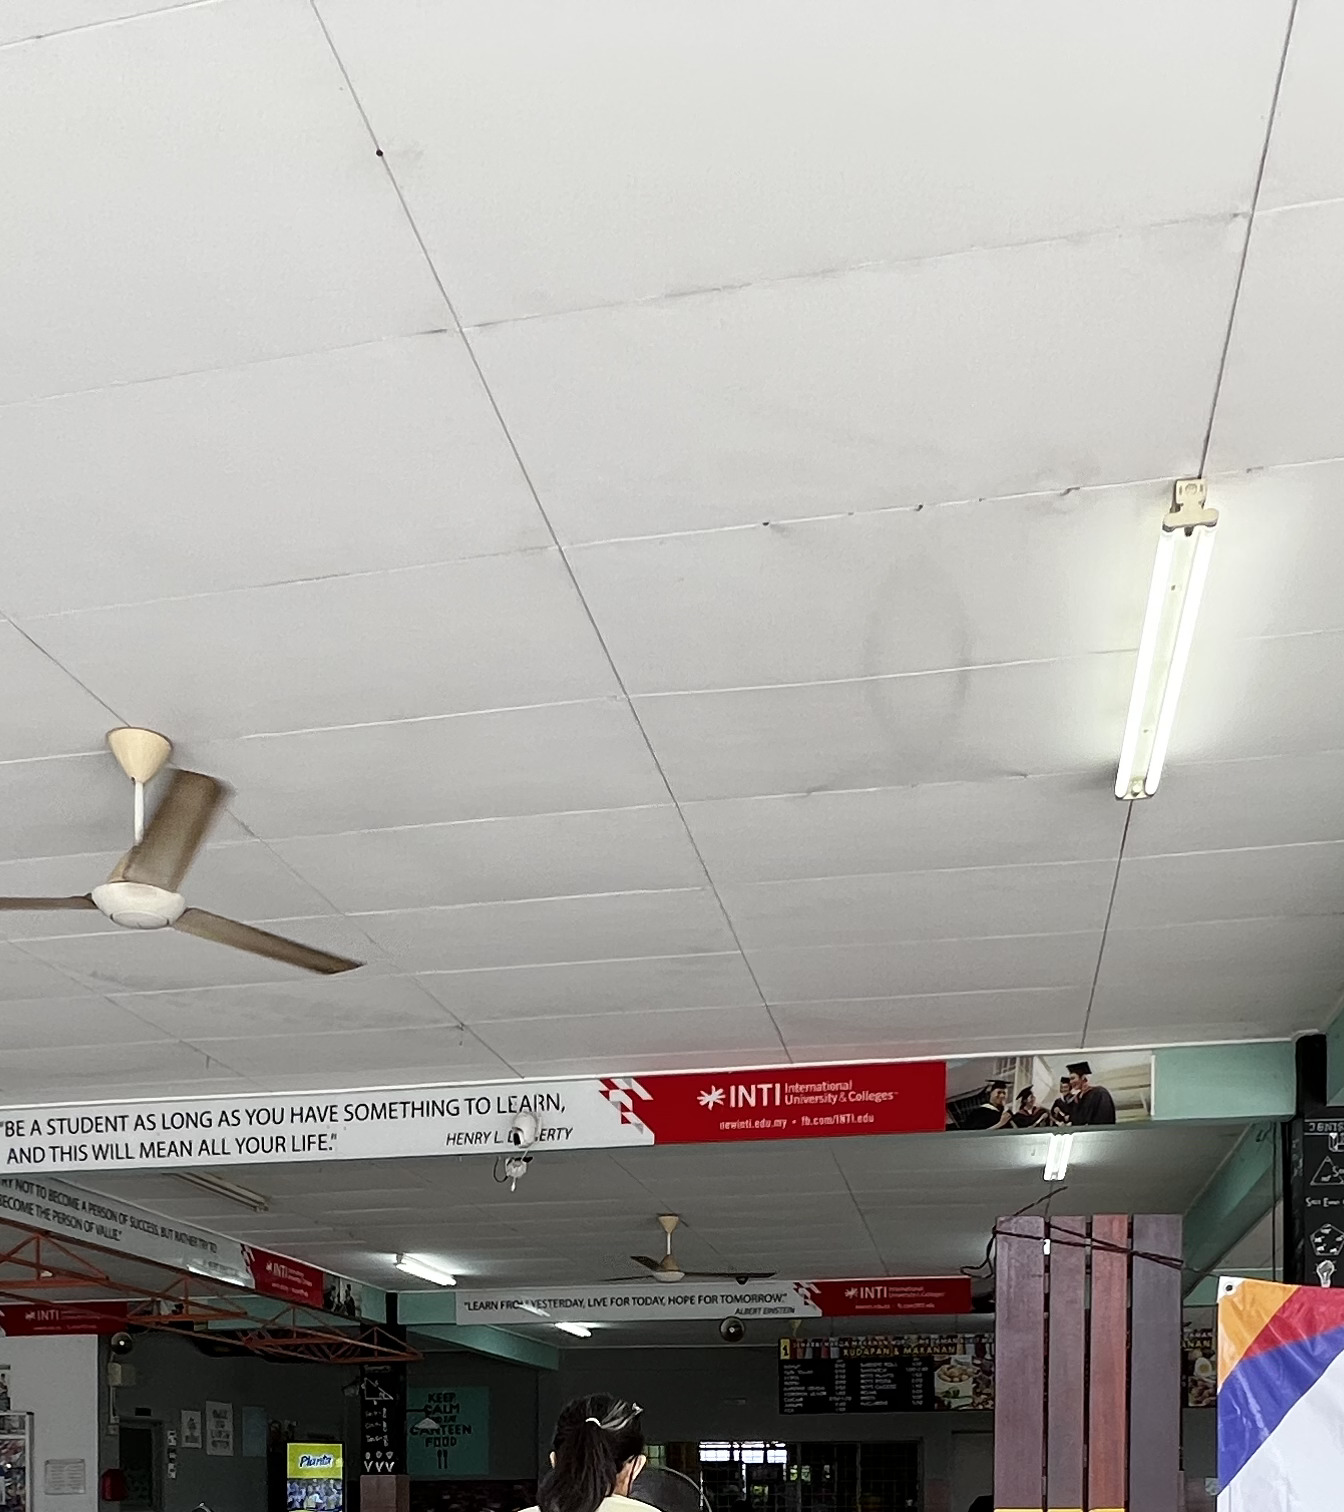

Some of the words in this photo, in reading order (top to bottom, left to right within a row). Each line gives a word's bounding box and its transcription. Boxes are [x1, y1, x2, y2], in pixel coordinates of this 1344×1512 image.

[784, 1079, 853, 1094] International
[729, 1082, 781, 1109] INTI
[784, 1093, 838, 1106] University
[838, 1092, 847, 1102] &
[30, 1119, 42, 1136] A
[46, 1115, 129, 1136] STUDENT
[133, 1113, 157, 1132] AS
[161, 1110, 213, 1130] LONG
[217, 1109, 241, 1128] AS
[245, 1107, 285, 1126] YOU
[290, 1105, 339, 1124] HAVE
[343, 1099, 460, 1123] SOMETHING
[464, 1096, 491, 1116] TO
[497, 1092, 566, 1114] LEARN,
[446, 1130, 492, 1146] HENRY
[7, 1147, 45, 1165] AND
[48, 1144, 88, 1163] THIS
[91, 1142, 135, 1162] WILL
[139, 1140, 193, 1159] MEAN
[198, 1138, 231, 1157] ALL
[235, 1135, 286, 1155] YOUR
[291, 1132, 338, 1153] LIFE."
[16, 1179, 34, 1195] NOT
[36, 1184, 47, 1199] TO
[48, 1188, 80, 1211] BECOME
[88, 1202, 118, 1223] PERSON
[118, 1212, 129, 1225] OF
[36, 1204, 52, 1222] THE
[52, 1209, 83, 1231] PERSON
[84, 1220, 95, 1233] OF
[273, 1262, 288, 1279] INTI
[860, 1285, 888, 1300] INTI
[530, 1297, 586, 1309] YESTERDAY,
[587, 1296, 608, 1308] LIVE
[610, 1296, 630, 1307] FOR
[631, 1295, 667, 1308] TODAY,
[668, 1294, 696, 1306] HOPE
[697, 1294, 719, 1305] FOR
[37, 1309, 59, 1321] INTI
[843, 1347, 889, 1357] KUDAPAN
[903, 1345, 956, 1355] MAKANAN
[428, 1392, 456, 1403] KEEP
[424, 1403, 460, 1415] CALM
[425, 1437, 457, 1448] FOOD
